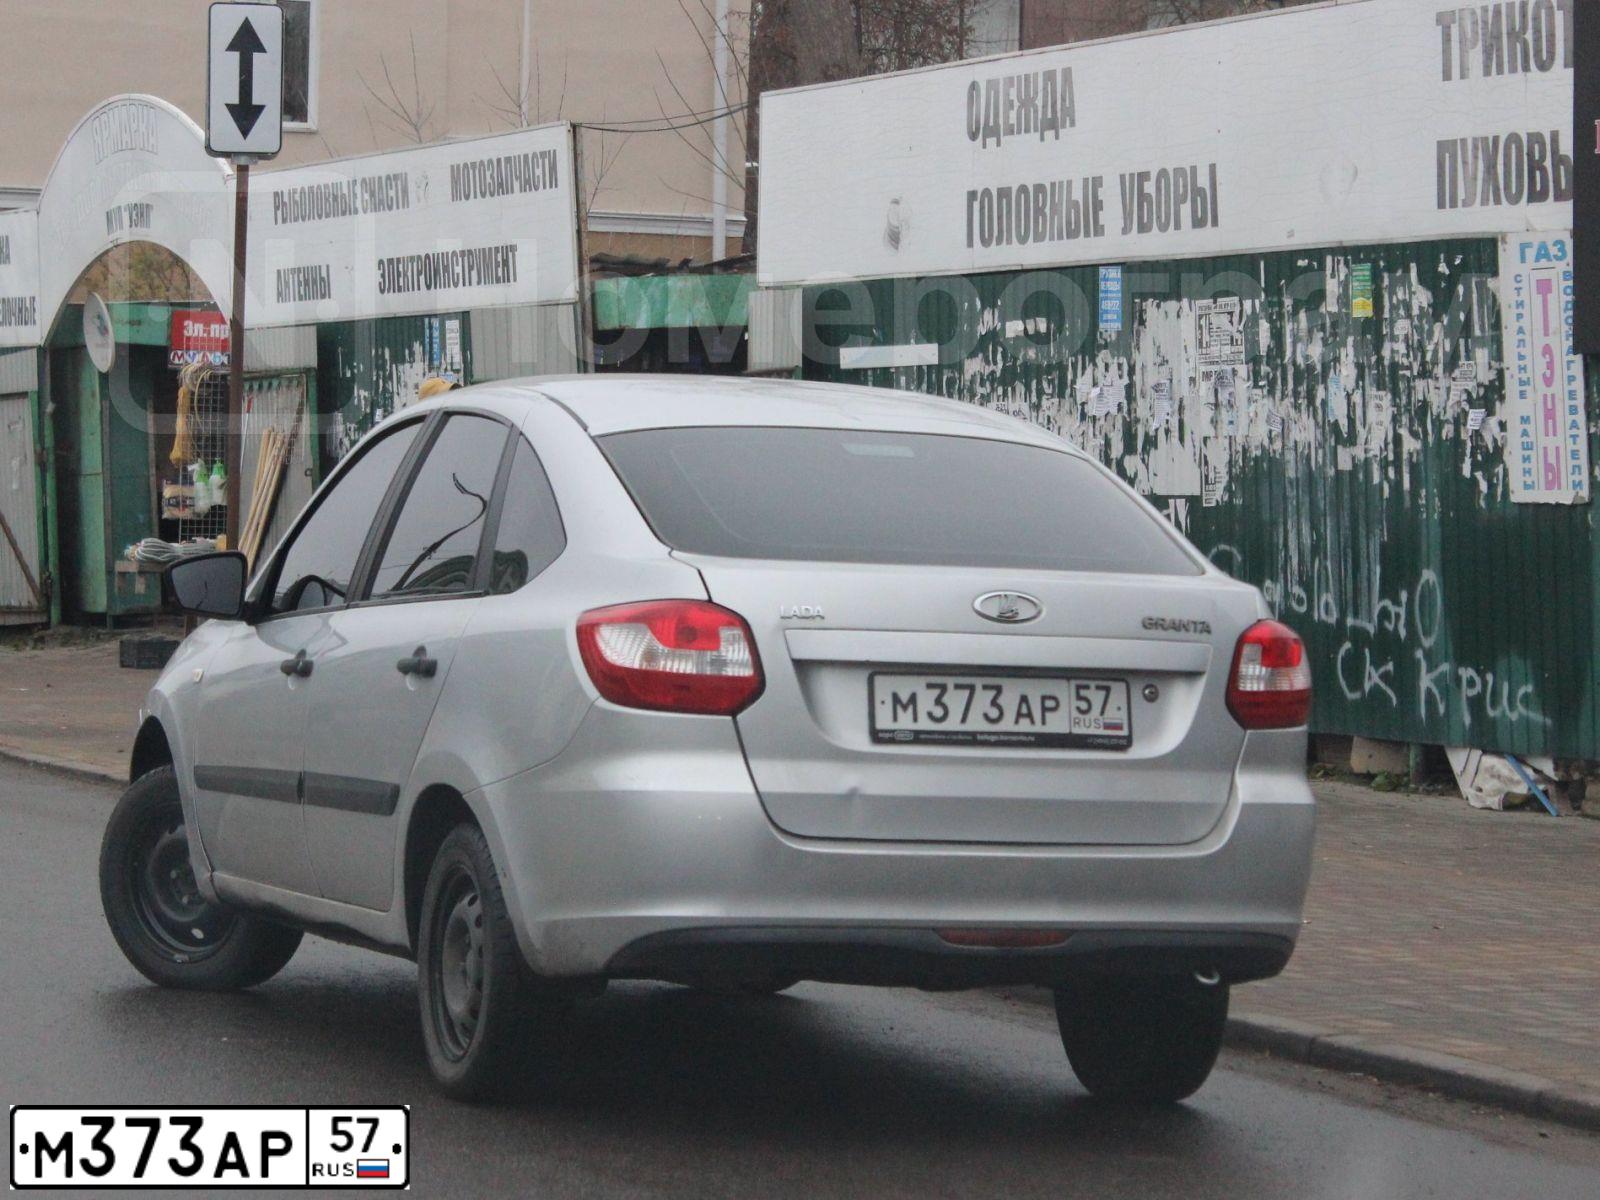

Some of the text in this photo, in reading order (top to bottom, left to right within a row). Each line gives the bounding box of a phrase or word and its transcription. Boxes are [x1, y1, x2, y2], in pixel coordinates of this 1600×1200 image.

[966, 66, 1076, 149] ОДЕЖДА
[92, 102, 158, 165] ЯРМАРКА
[272, 172, 410, 226] РЫБОЛОВНЫЕ СНАСТИ
[450, 149, 559, 202] МОТОЗАПЧАСТИ
[966, 163, 1219, 248] ГОЛОВНЫЕ УБОРЫ
[378, 244, 518, 294] ЭЛЕКТРОИНСТРУМЕНТ
[1519, 240, 1568, 264] ГАЗ
[276, 264, 331, 303] АНТЕННЫ
[0, 296, 37, 327] ЛОЧНЫЕ
[1514, 274, 1535, 491] СТИРАЛЬНЫЕ МАШИНЫ
[1536, 279, 1562, 491] ТЭНЫ
[780, 605, 825, 619] LADA
[1141, 616, 1212, 635] GRANTA
[892, 683, 1112, 727] М373АР 57
[1073, 717, 1101, 730] RUS
